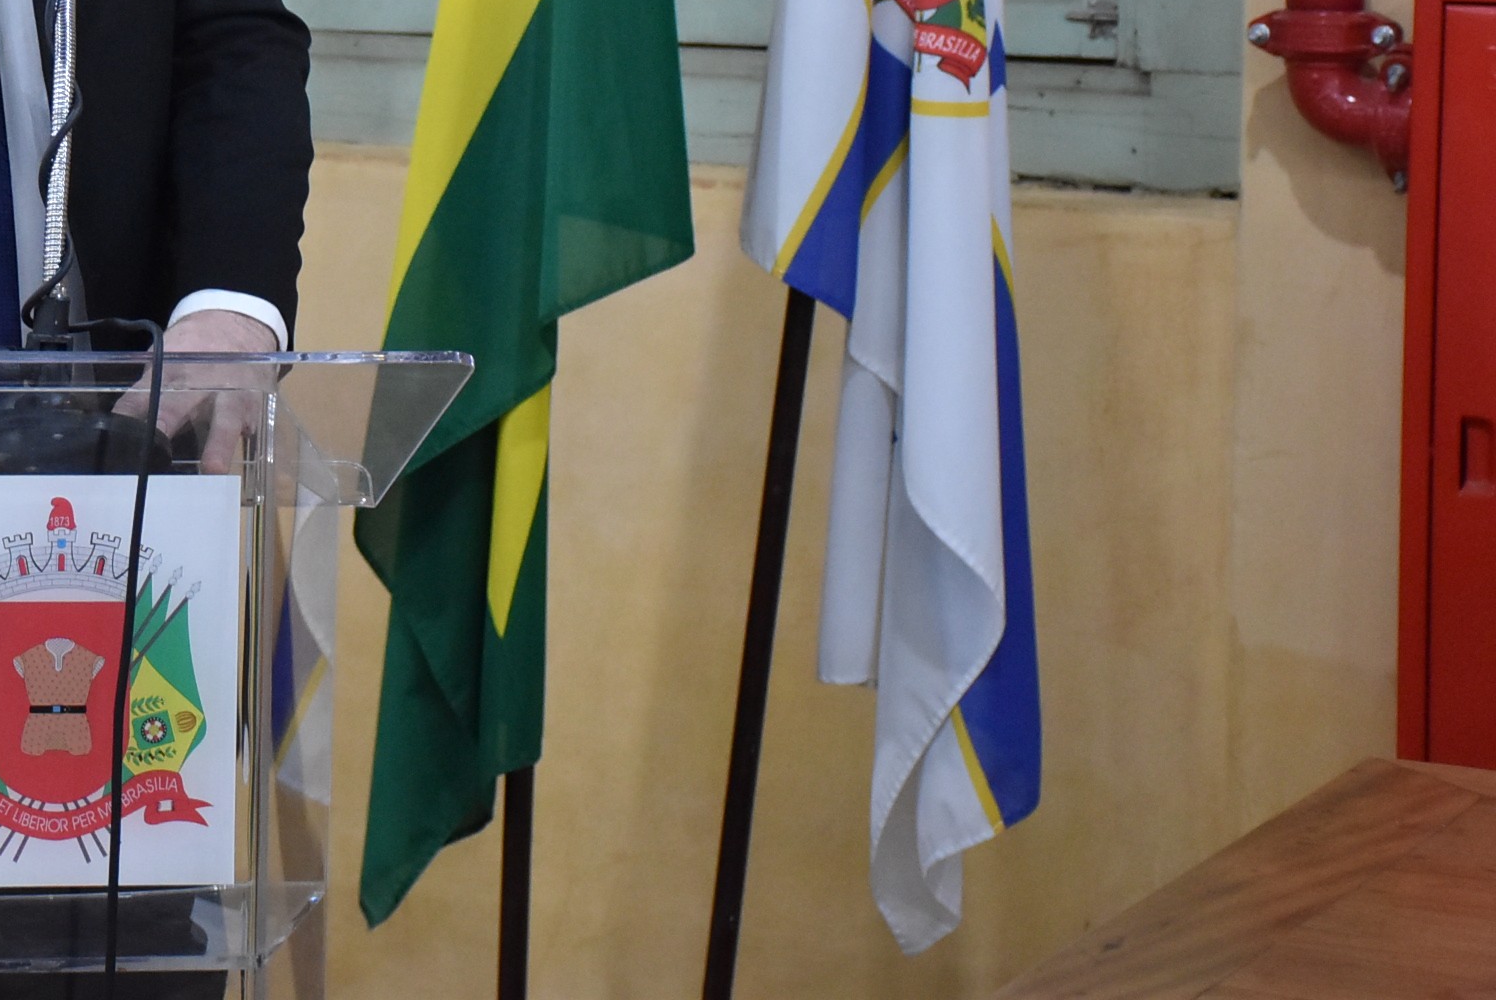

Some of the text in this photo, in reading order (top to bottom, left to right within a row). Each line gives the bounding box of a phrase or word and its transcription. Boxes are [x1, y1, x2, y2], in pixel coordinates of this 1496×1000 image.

[918, 31, 981, 63] BRASILIA
[49, 516, 70, 528] 1873
[12, 807, 69, 833] LIBERIOR
[71, 811, 97, 831] PER
[120, 776, 179, 808] BRASILIA
